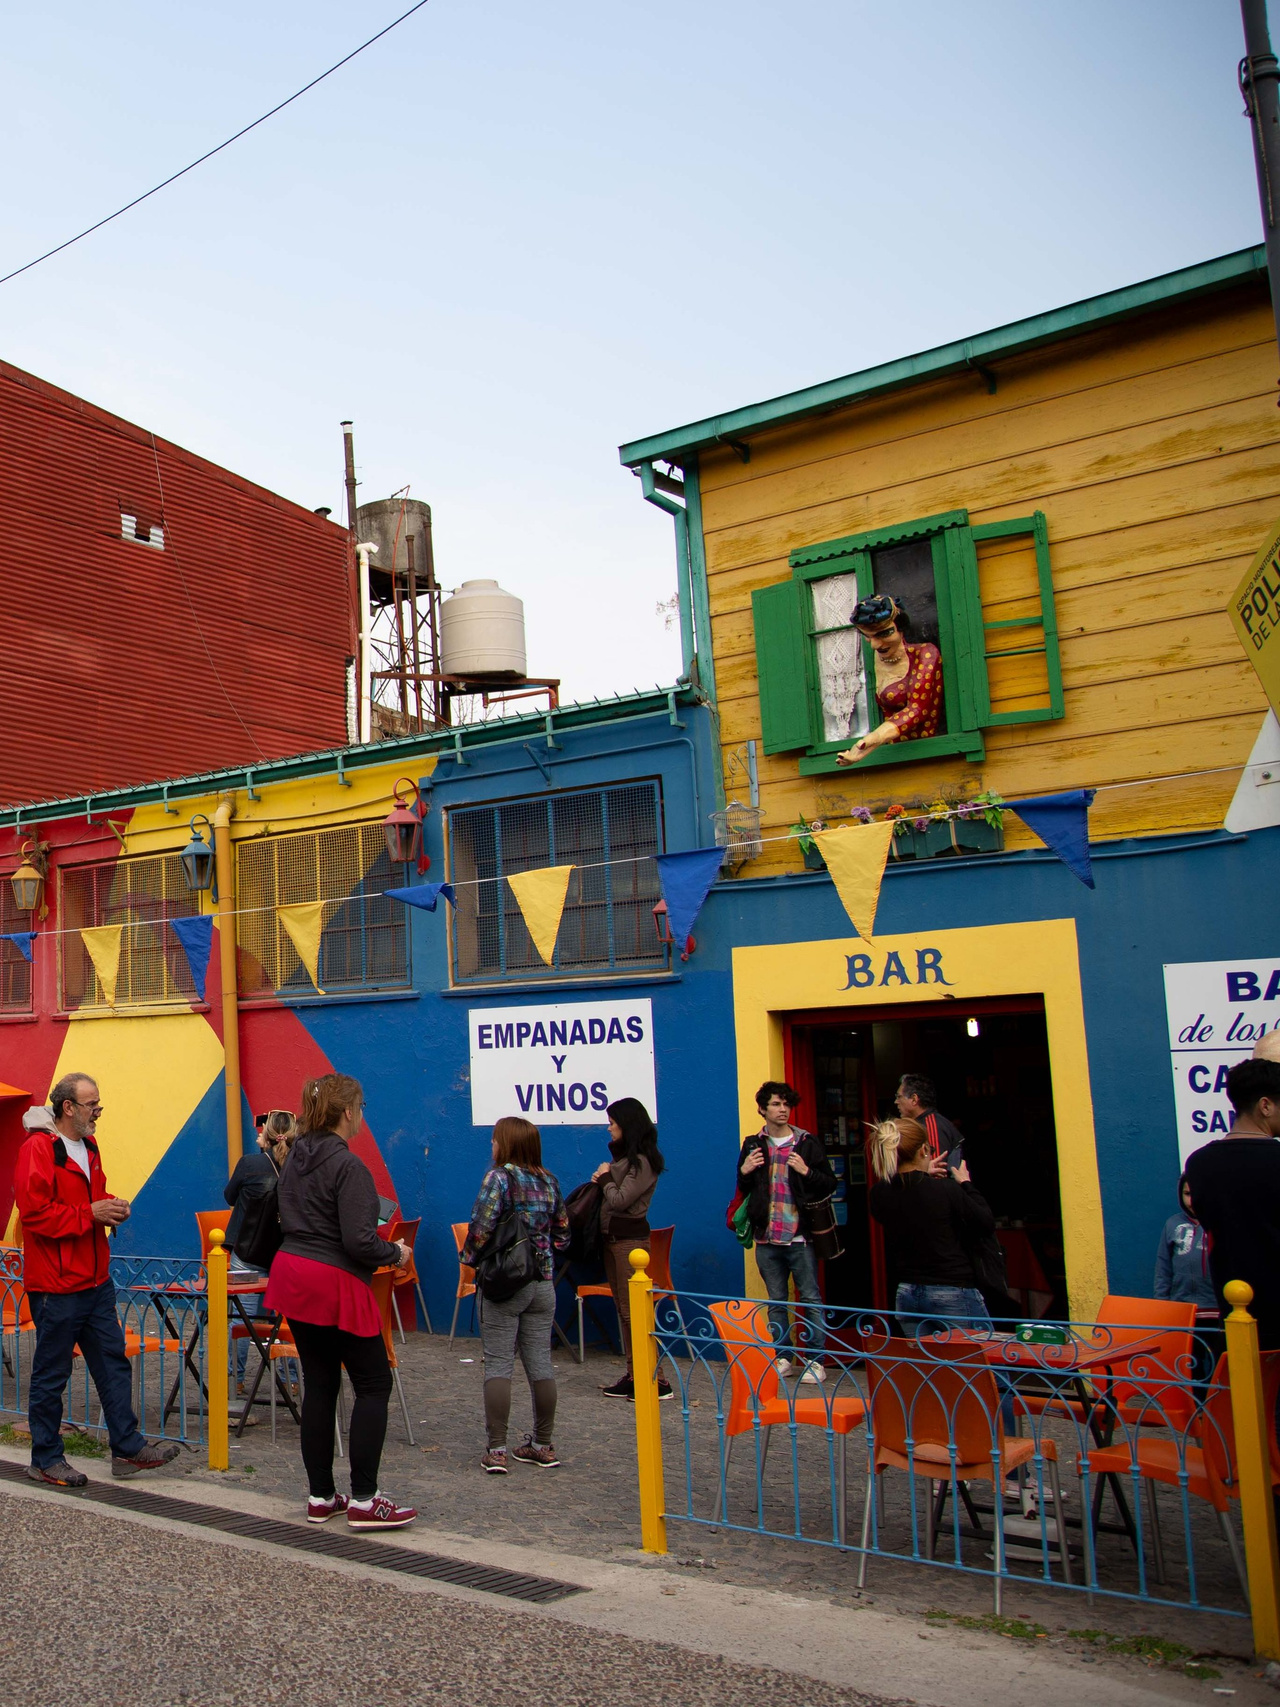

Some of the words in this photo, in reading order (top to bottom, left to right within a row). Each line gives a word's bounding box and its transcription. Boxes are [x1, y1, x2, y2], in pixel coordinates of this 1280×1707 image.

[1236, 581, 1254, 612] ESPACIO
[1240, 547, 1280, 635] POLI
[1251, 621, 1271, 651] DE
[837, 948, 959, 991] BAR
[478, 1016, 643, 1049] EMPANADAS
[1178, 1014, 1214, 1043] de
[1226, 1012, 1267, 1042] los
[551, 1055, 567, 1073] Y
[515, 1082, 608, 1112] VINOS
[374, 1504, 391, 1520] N
